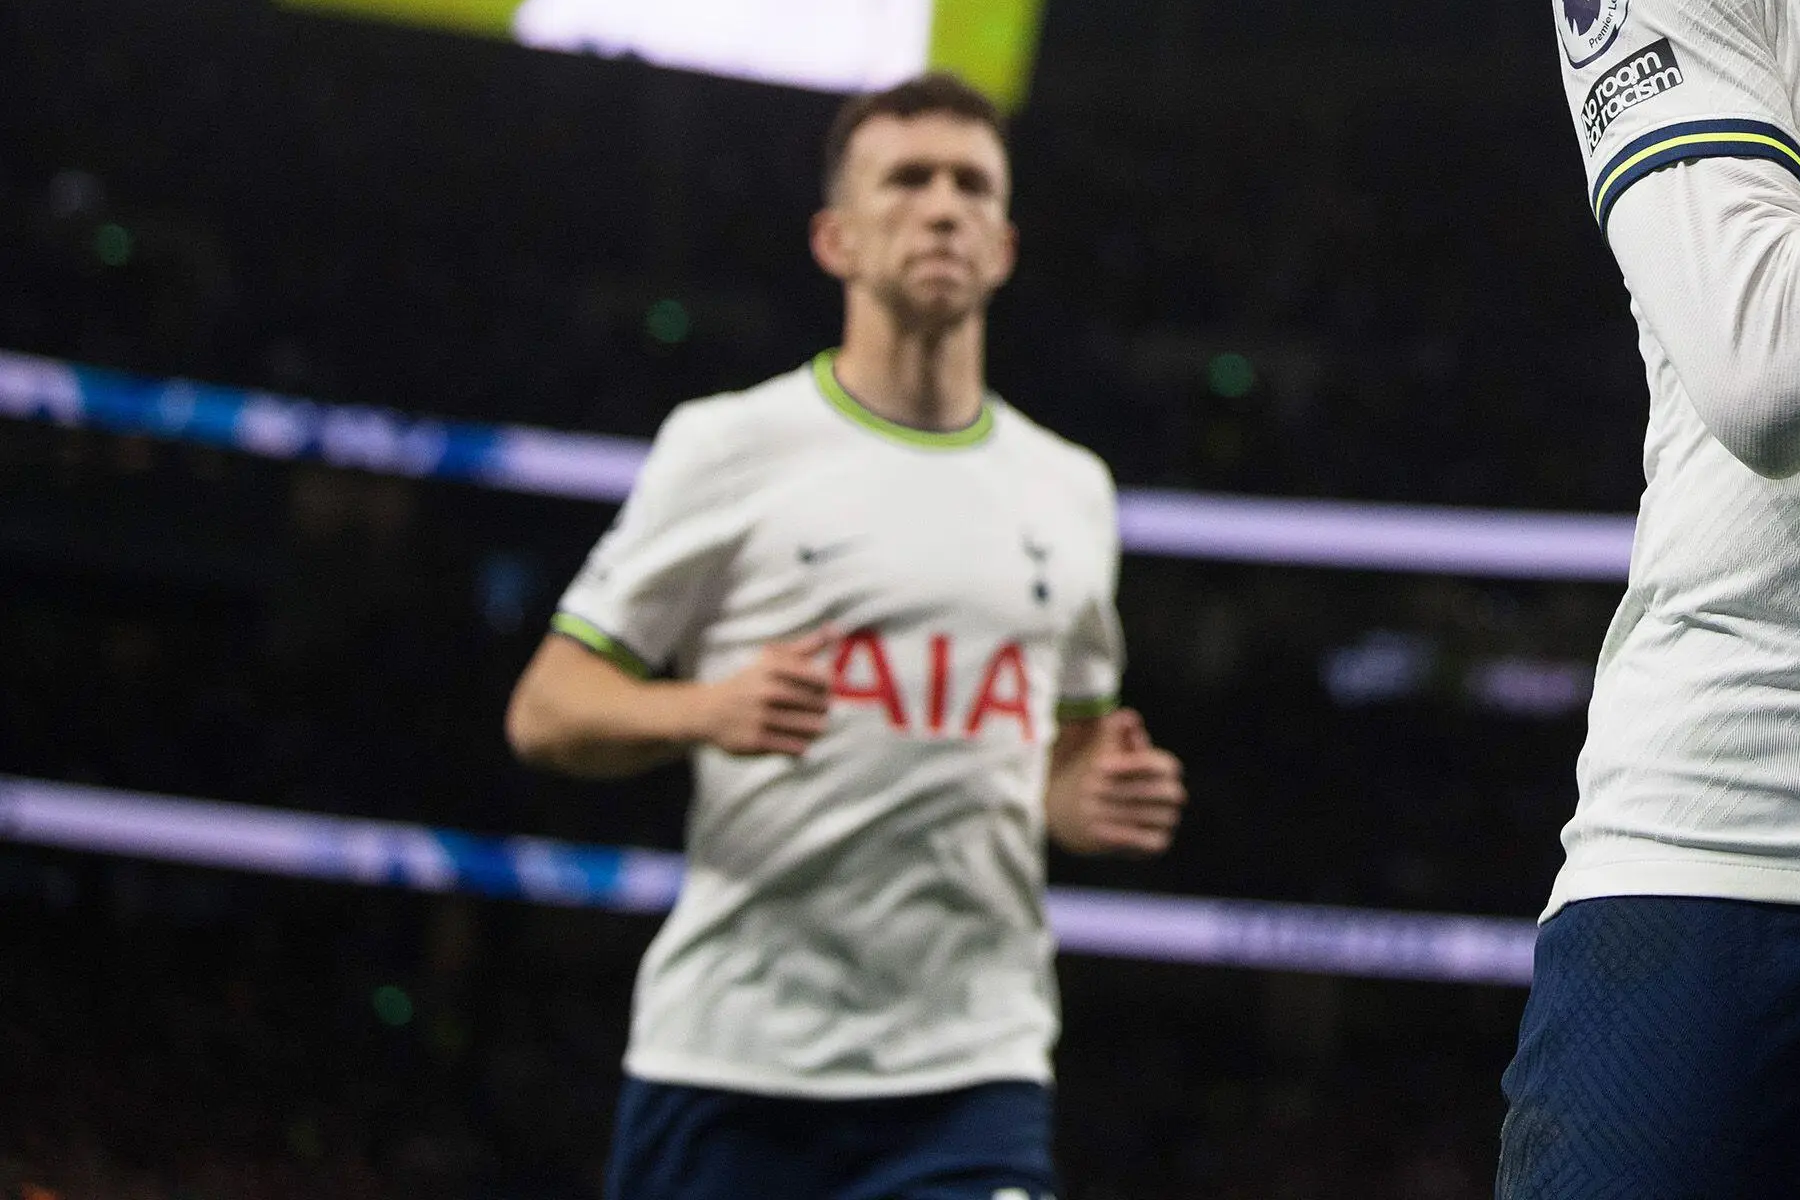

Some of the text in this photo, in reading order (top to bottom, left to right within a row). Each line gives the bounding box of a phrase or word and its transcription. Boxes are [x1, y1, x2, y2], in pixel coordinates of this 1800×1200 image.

[1588, 12, 1614, 49] Premier
[1581, 51, 1662, 129] No room
[1600, 67, 1682, 127] racism
[830, 630, 1034, 740] AIA
